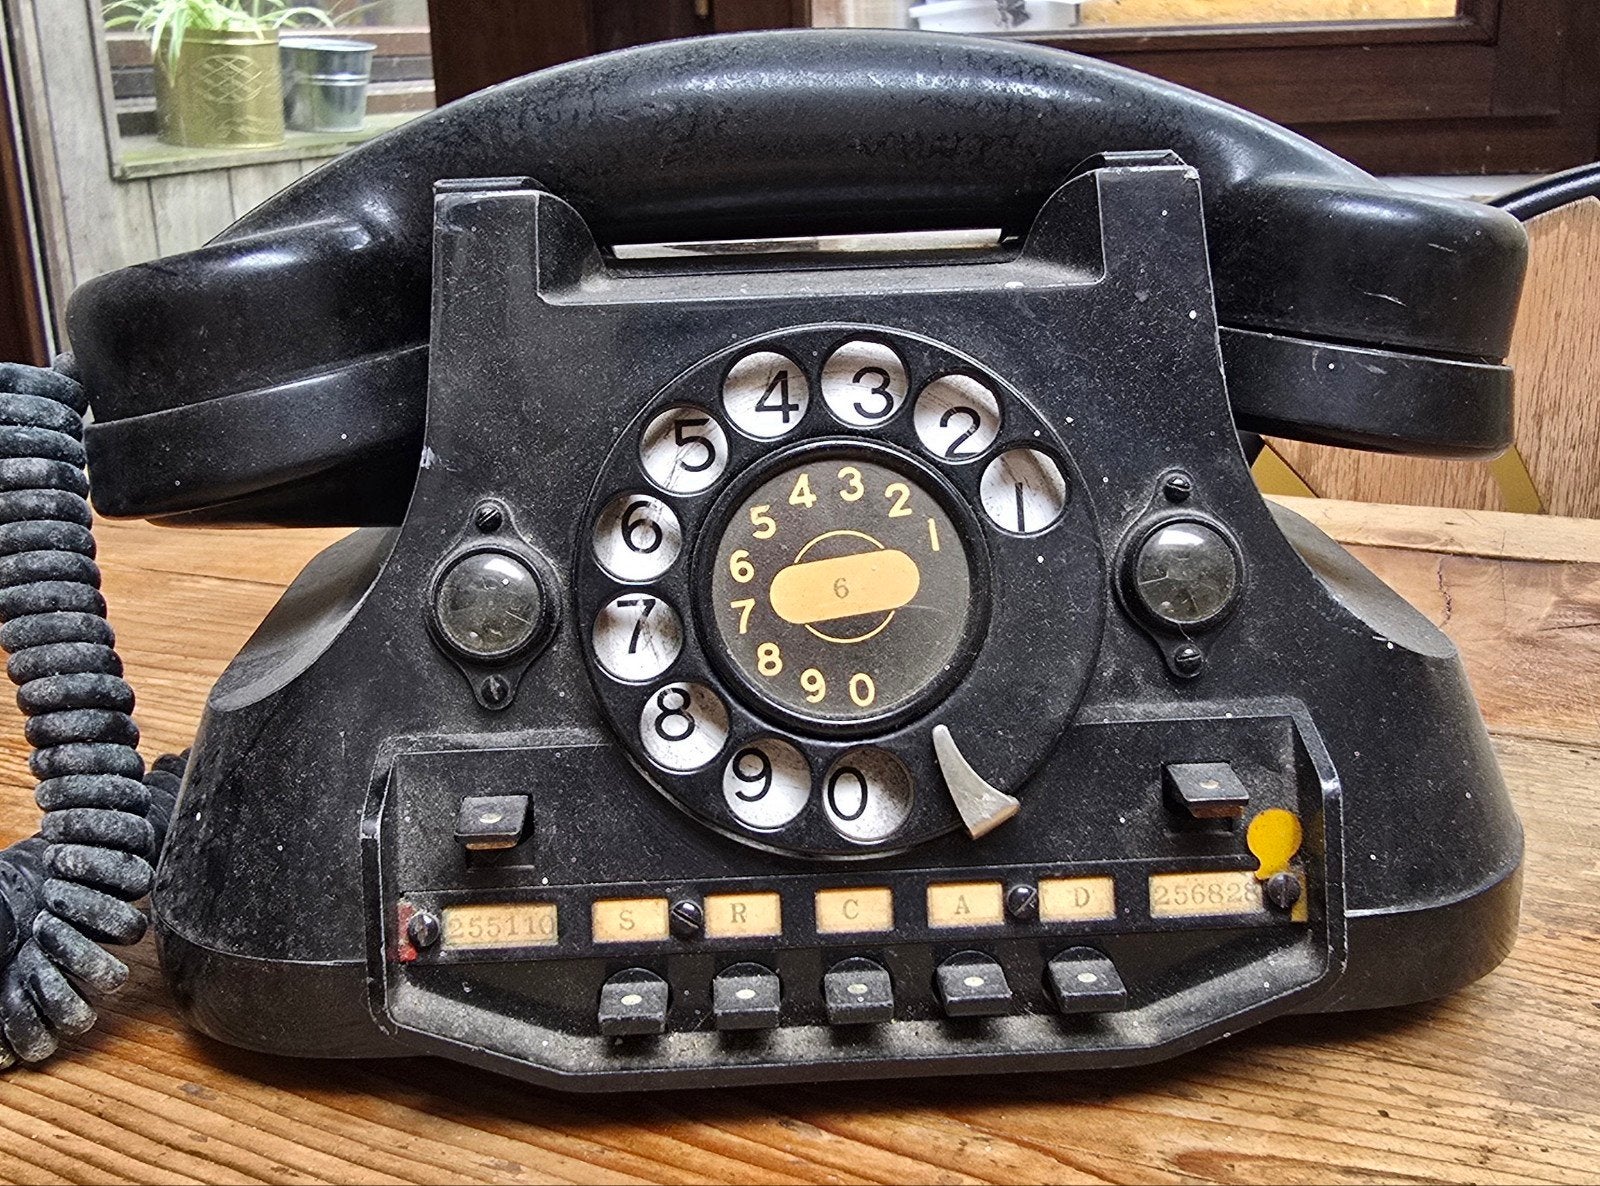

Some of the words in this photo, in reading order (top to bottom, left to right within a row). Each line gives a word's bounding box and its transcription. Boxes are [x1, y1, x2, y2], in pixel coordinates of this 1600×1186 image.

[756, 370, 799, 423] 4
[852, 367, 893, 418] 3
[674, 419, 716, 472] 5
[940, 407, 981, 457] 2
[788, 473, 817, 509] 4
[837, 467, 864, 501] 3
[885, 483, 912, 517] 2
[750, 505, 776, 539] 5
[1015, 482, 1026, 532] 1
[621, 500, 662, 553] 6
[928, 518, 940, 551] 1
[729, 550, 755, 583] 6
[833, 577, 849, 598] 6
[616, 599, 656, 654] 7
[731, 599, 756, 634] 7
[757, 643, 783, 676] 8
[800, 668, 826, 702] 9
[849, 673, 875, 706] 0
[654, 688, 695, 741] 8
[732, 748, 771, 802] 9
[828, 767, 867, 820] 0
[843, 898, 860, 919] C
[954, 894, 972, 916] A
[1074, 887, 1091, 908] D
[1154, 881, 1259, 906] 256828
[618, 909, 636, 931] S
[730, 901, 748, 924] R
